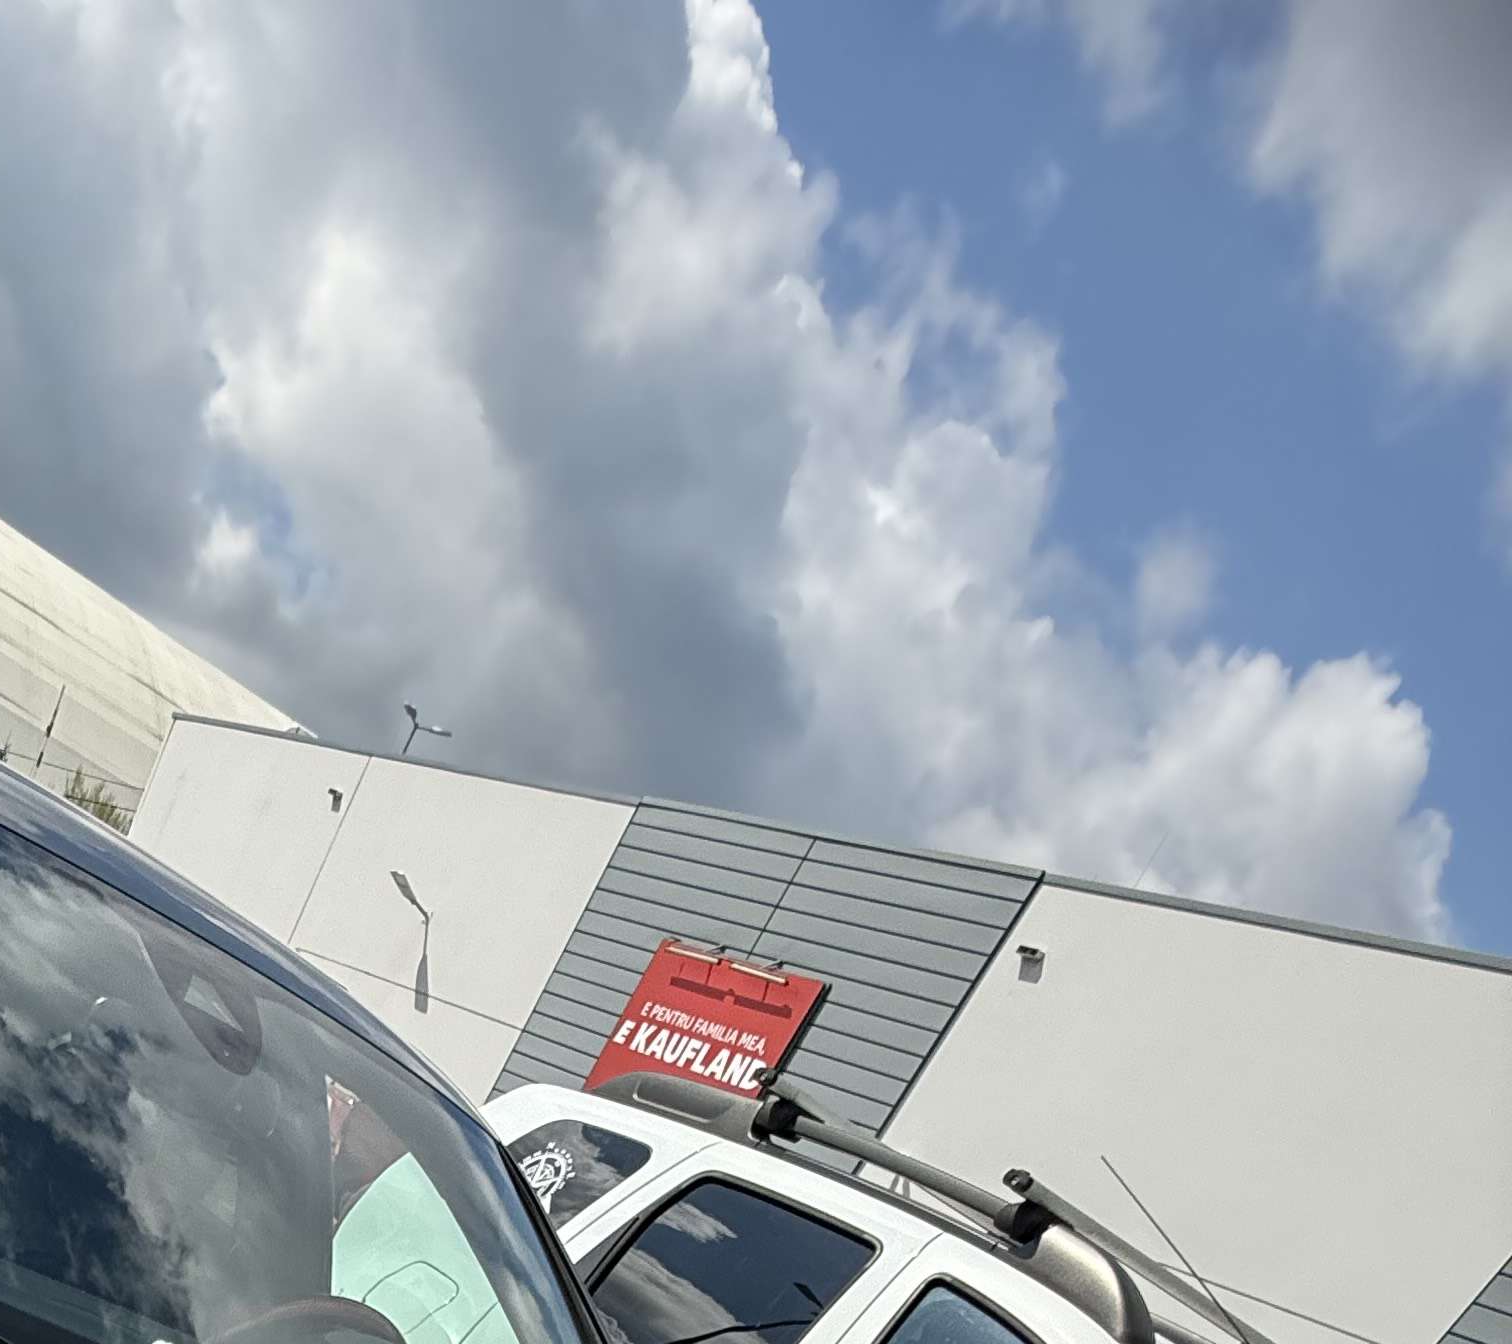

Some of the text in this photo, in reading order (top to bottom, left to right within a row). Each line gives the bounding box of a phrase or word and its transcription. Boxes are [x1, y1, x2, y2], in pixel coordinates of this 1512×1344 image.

[649, 1004, 694, 1030] PENTRU
[692, 1017, 739, 1045] FAMILIA
[613, 1020, 767, 1090] E KAUFLAND
